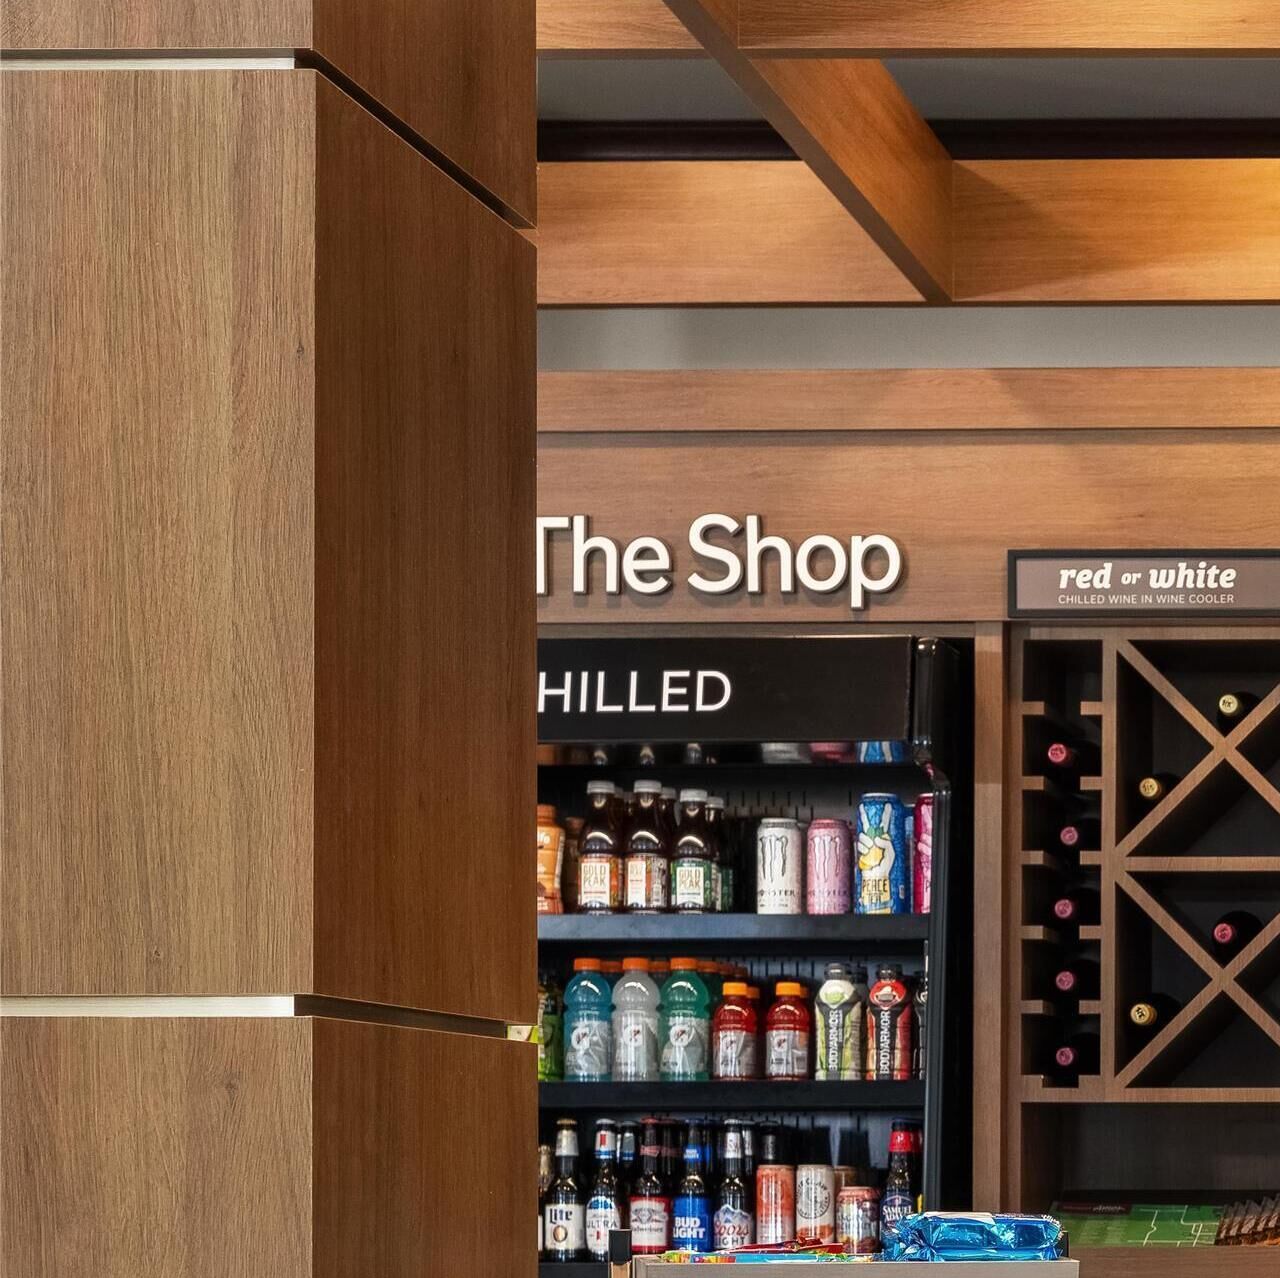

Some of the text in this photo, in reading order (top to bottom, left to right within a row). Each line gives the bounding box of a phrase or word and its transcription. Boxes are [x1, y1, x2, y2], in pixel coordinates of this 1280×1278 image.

[688, 513, 901, 609] Shop
[1058, 561, 1237, 590] red or white
[1058, 593, 1235, 604] CHILLED WINE IN WINE COOLER
[537, 670, 732, 712] HILLED
[880, 1010, 890, 1074] BODYARMOR
[549, 1208, 573, 1225] Lite
[587, 1219, 618, 1229] ULTRA
[675, 1216, 700, 1227] BUD
